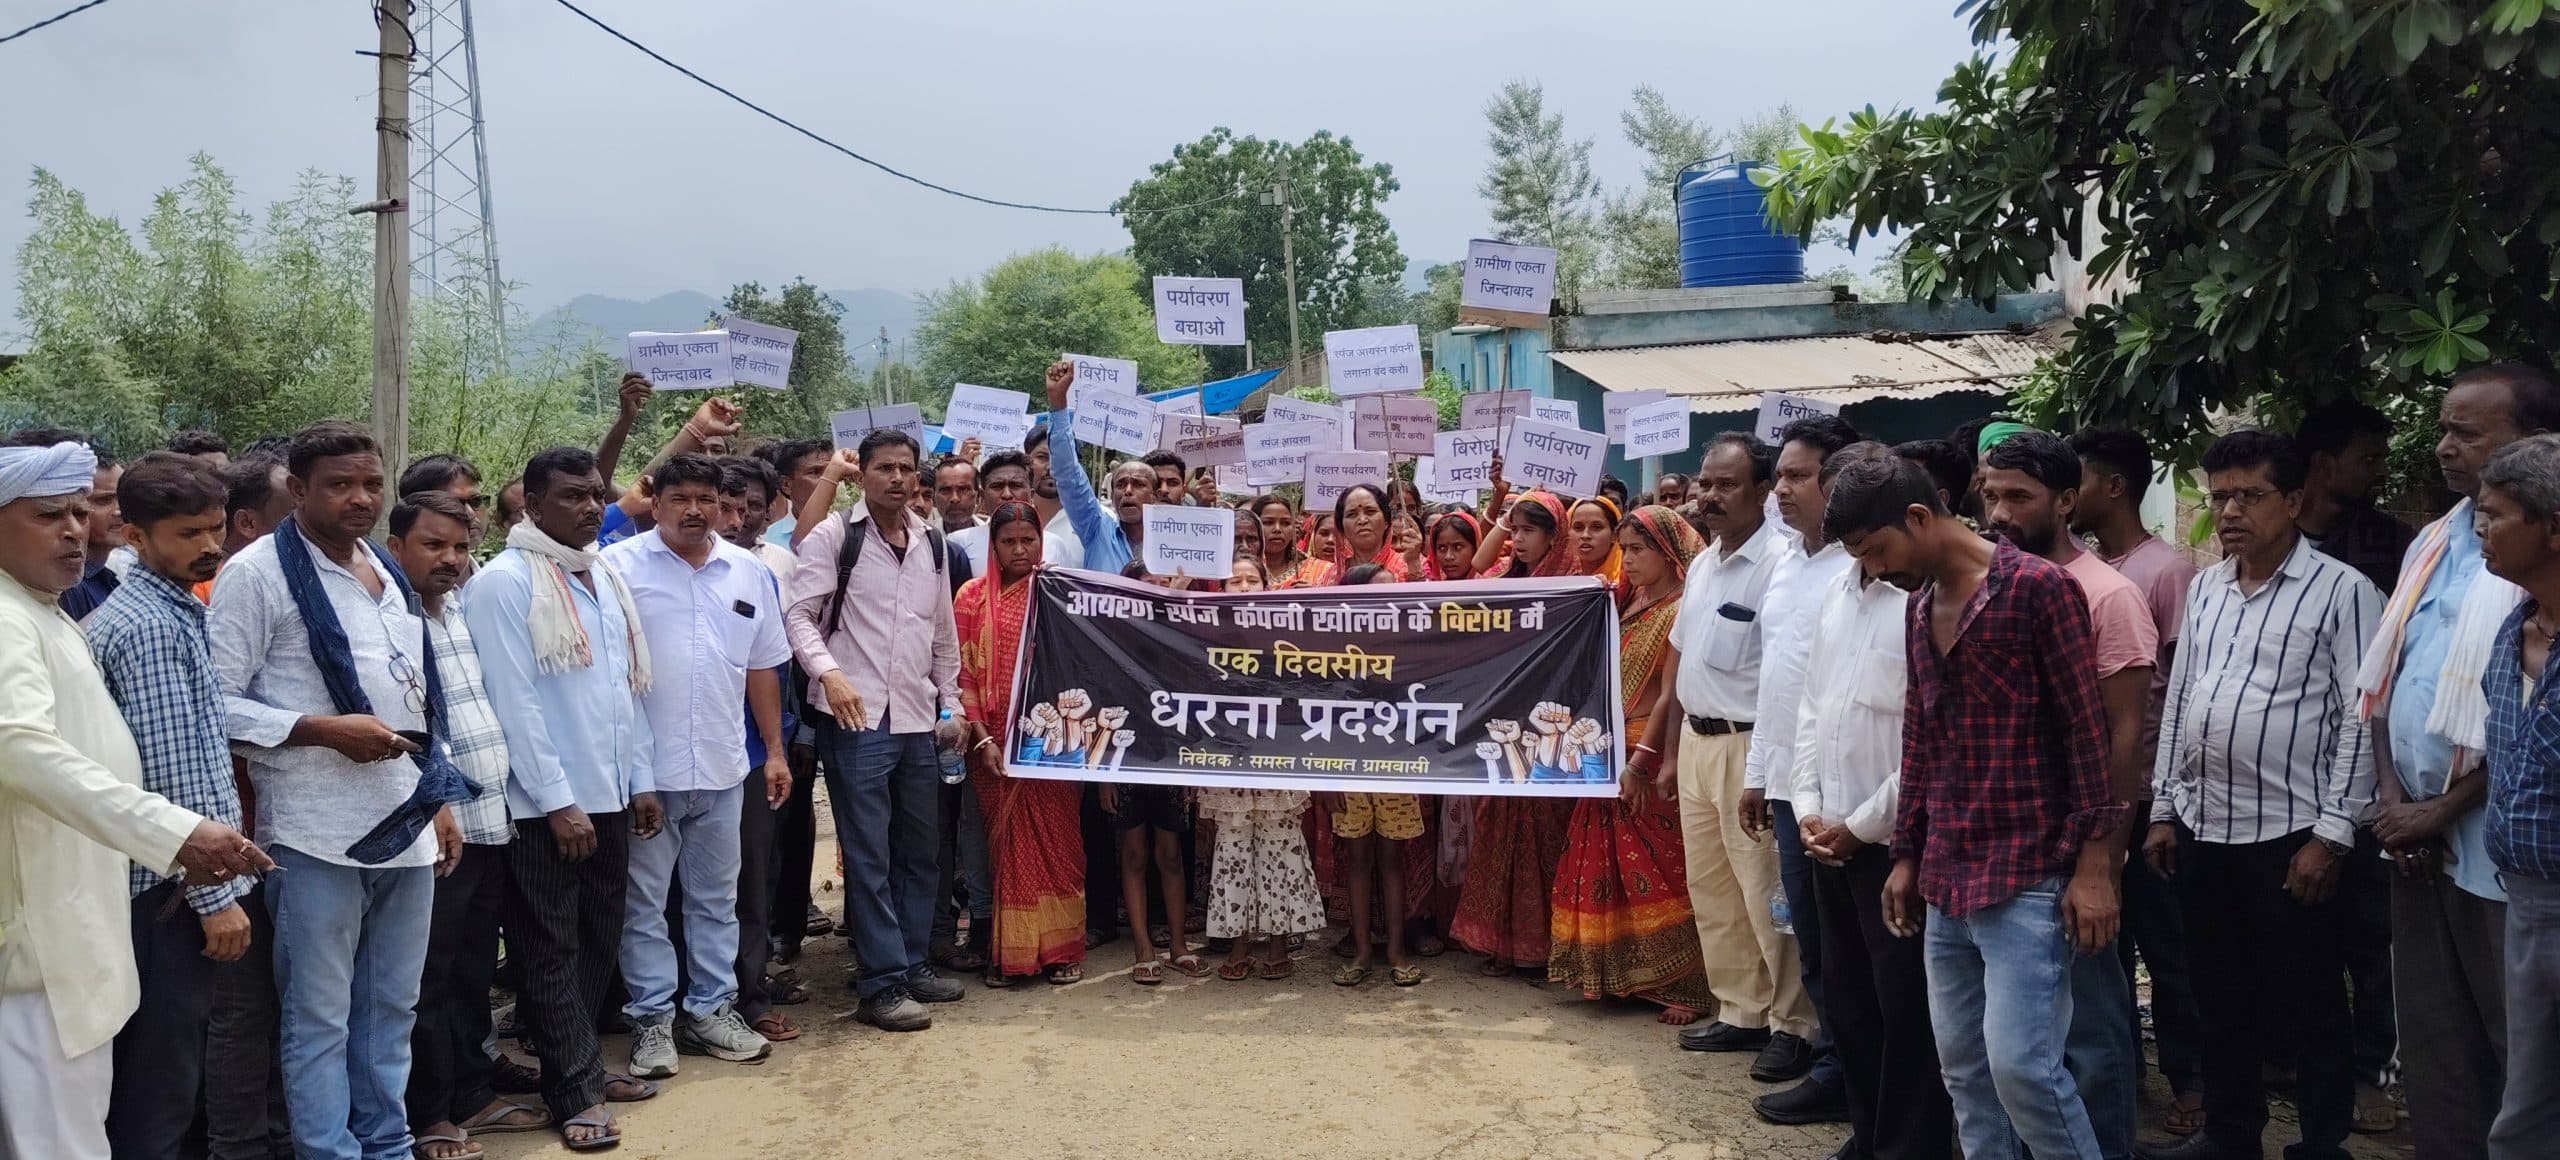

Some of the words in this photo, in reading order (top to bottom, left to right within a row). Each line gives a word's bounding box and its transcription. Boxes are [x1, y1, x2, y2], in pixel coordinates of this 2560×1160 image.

[1475, 255, 1511, 271] ग्रामीण
[1515, 262, 1546, 274] एकता
[1166, 286, 1230, 306] पर्यावरण
[1174, 316, 1226, 336] बचाओ
[638, 341, 679, 358] ग्रामीण
[683, 342, 719, 357] एकता
[729, 330, 750, 346] पंज
[752, 336, 790, 353] आयरन
[1356, 346, 1386, 356] आयरन
[1390, 344, 1414, 354] कंपनी
[652, 367, 712, 382] जिन्दाबाद
[750, 358, 780, 376] चलेगा
[1078, 361, 1120, 382] बिरोध
[1344, 368, 1371, 379] लगाना
[956, 418, 980, 428] लगाना
[1536, 405, 1572, 424] पर्यावरण
[1662, 428, 1680, 440] कल
[1453, 437, 1496, 457] बिरोध
[1524, 431, 1592, 460] पर्यावरण
[1252, 457, 1276, 468] हटाओ
[1450, 461, 1490, 481] प्रदर्श
[1523, 461, 1578, 488] बचाओ
[1151, 518, 1188, 534] ग्रामीण
[1190, 523, 1223, 536] एकता
[1232, 603, 1305, 631] कंपनी
[1312, 603, 1400, 633] खोलने
[1407, 602, 1433, 632] के
[1439, 601, 1512, 632] विरोध
[1207, 648, 1263, 681] एक
[1273, 640, 1396, 681] दिवसीय
[1150, 690, 1282, 740] धरना
[1299, 683, 1464, 746] प्रदर्शन
[1178, 747, 1233, 768] निवेदक
[1250, 755, 1296, 770] समस्त
[1302, 752, 1356, 772] पंचायत
[1362, 756, 1430, 774] ग्रामवासी
